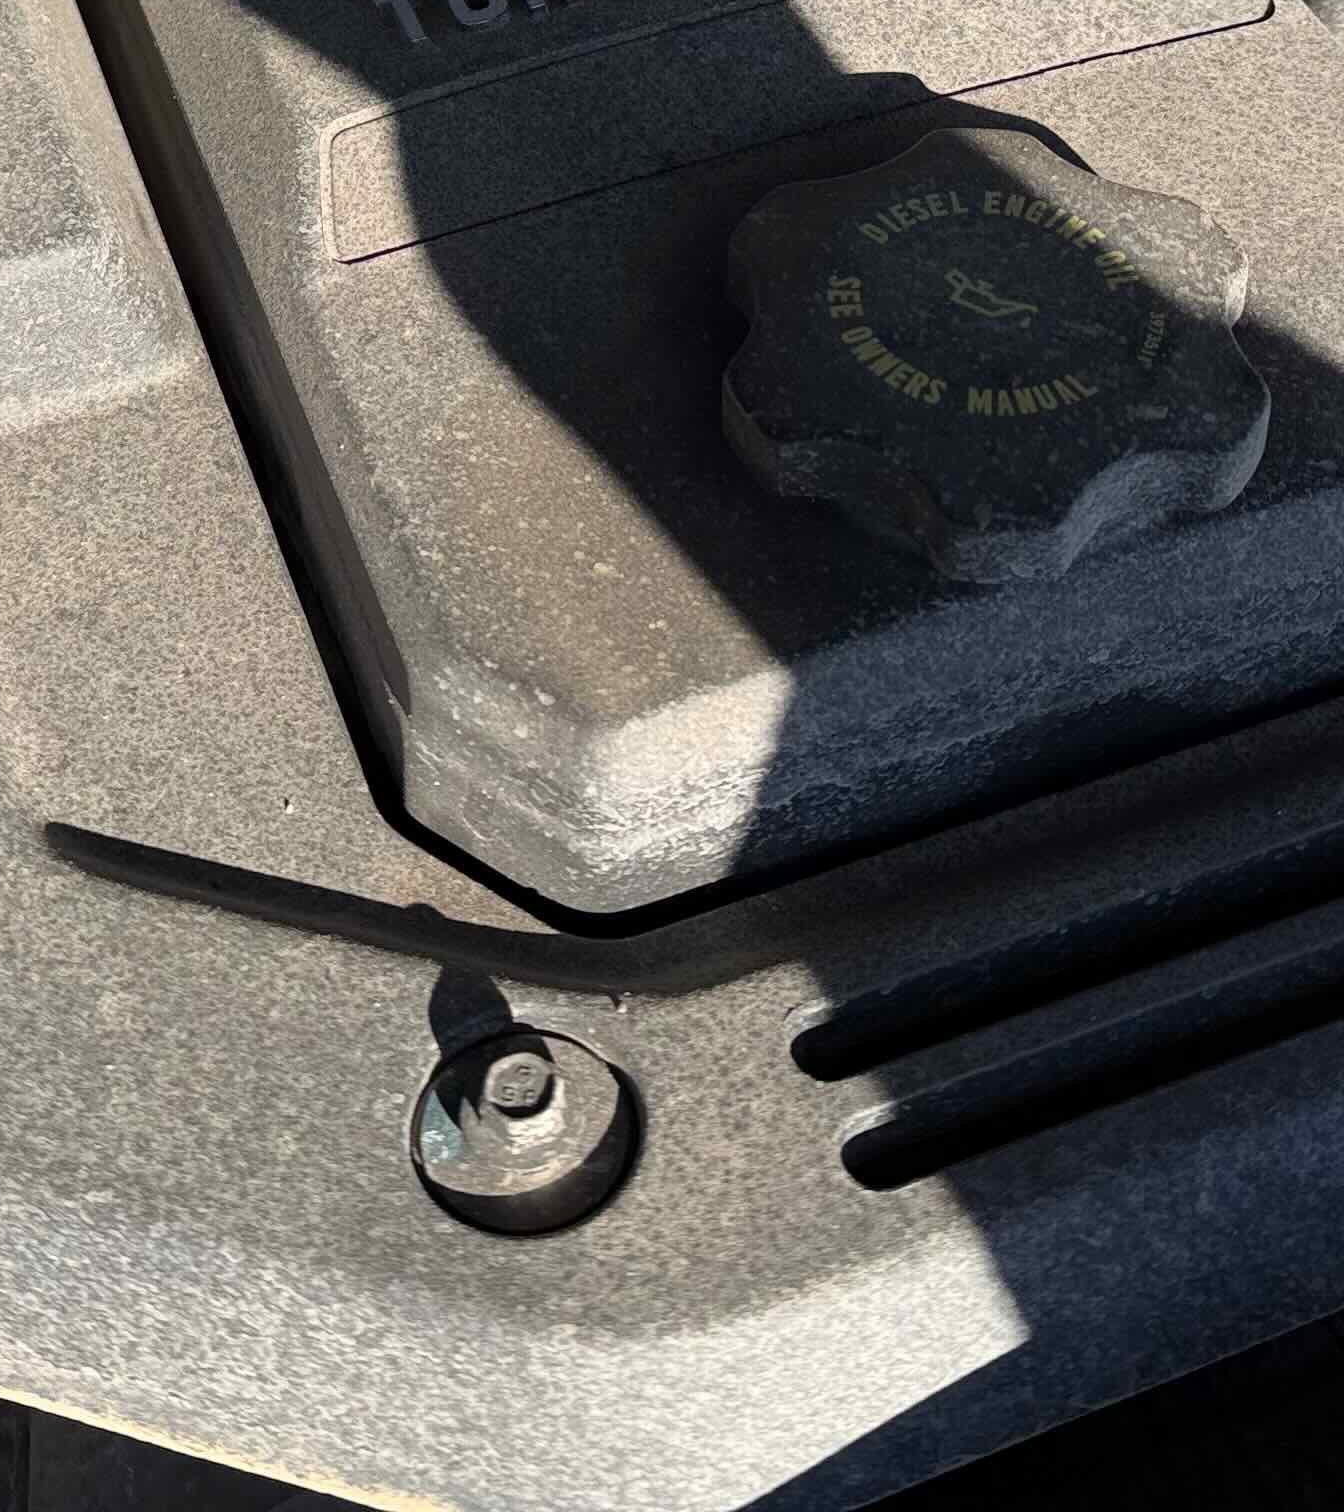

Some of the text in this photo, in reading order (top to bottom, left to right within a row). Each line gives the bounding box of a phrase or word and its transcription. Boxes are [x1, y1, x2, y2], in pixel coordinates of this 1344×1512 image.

[858, 191, 1140, 291] DIESEL ENGINE OIL
[827, 275, 1100, 416] SEE OWNERS MANUAL
